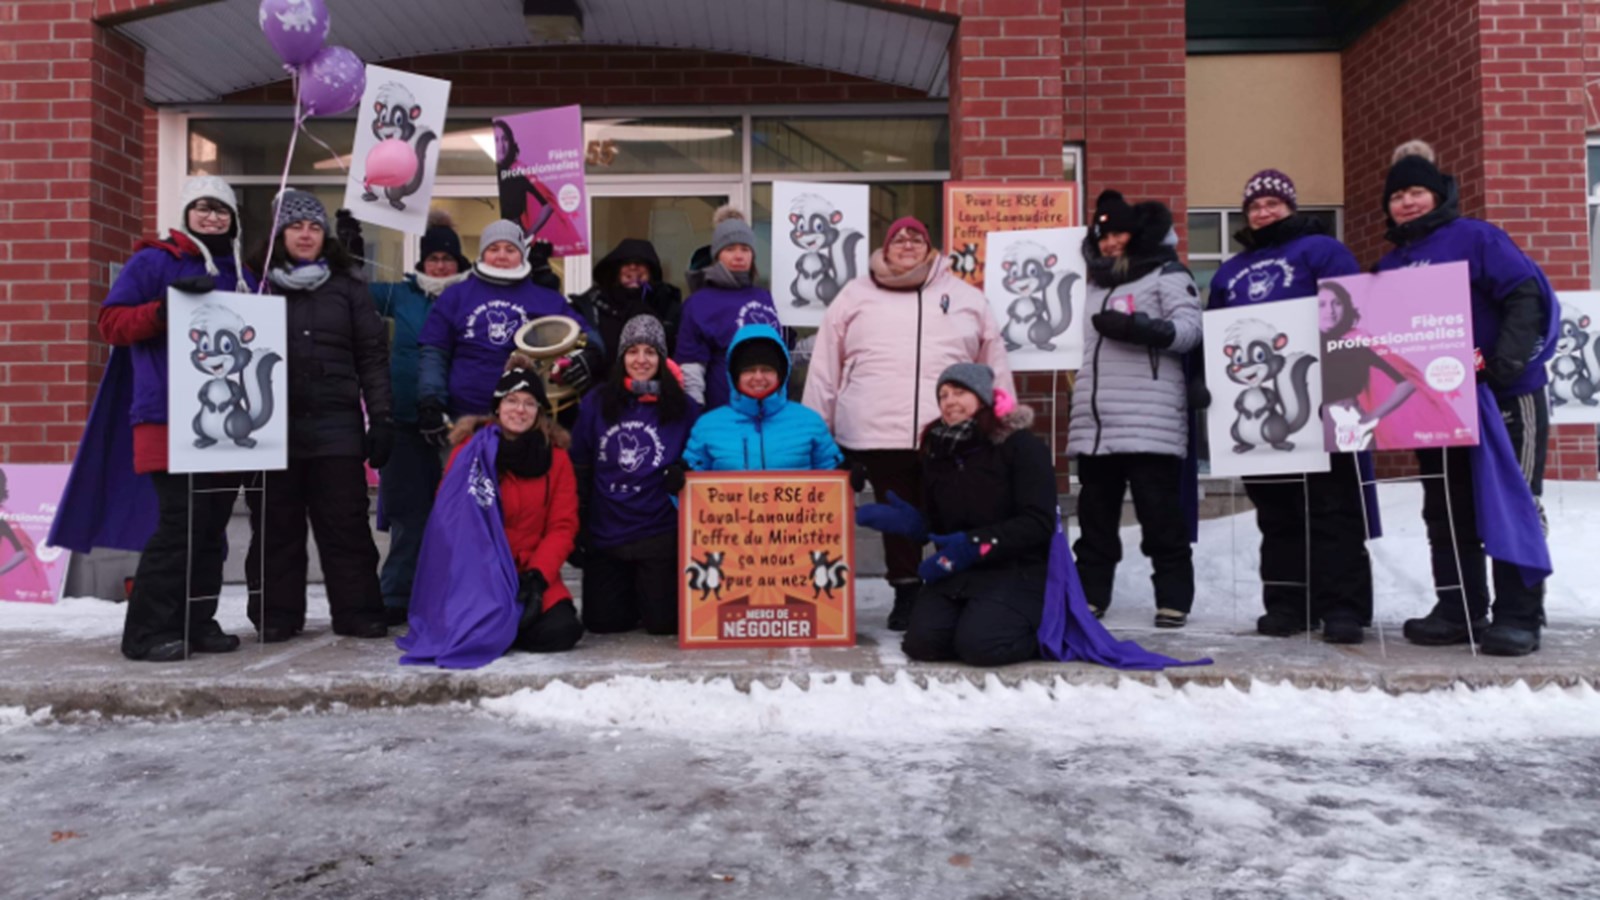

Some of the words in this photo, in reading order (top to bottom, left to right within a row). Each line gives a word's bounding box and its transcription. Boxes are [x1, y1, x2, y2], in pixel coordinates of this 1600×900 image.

[587, 140, 616, 166] 55
[500, 161, 580, 180] professionnelles
[965, 194, 993, 206] Pour
[996, 195, 1011, 207] les
[1016, 195, 1038, 206] RSE
[1042, 194, 1056, 207] de
[958, 211, 1064, 223] Laval-Lanaudière
[1411, 313, 1465, 329] Fières
[1327, 327, 1466, 353] professionnelles
[707, 487, 743, 504] Pour
[748, 487, 769, 502] les
[773, 487, 802, 503] RSE
[807, 486, 825, 502] de
[699, 508, 834, 525] Laval-Lanaudière
[693, 529, 739, 545] l'offre
[743, 530, 763, 544] du
[768, 529, 841, 546] Ministère
[737, 554, 755, 570] ça
[760, 553, 796, 566] nous
[725, 575, 752, 592] pue
[757, 575, 778, 588] au
[781, 574, 808, 588] nez
[746, 608, 775, 619] MERCI
[776, 608, 789, 619] DE
[723, 618, 811, 638] NÉGOCIER
